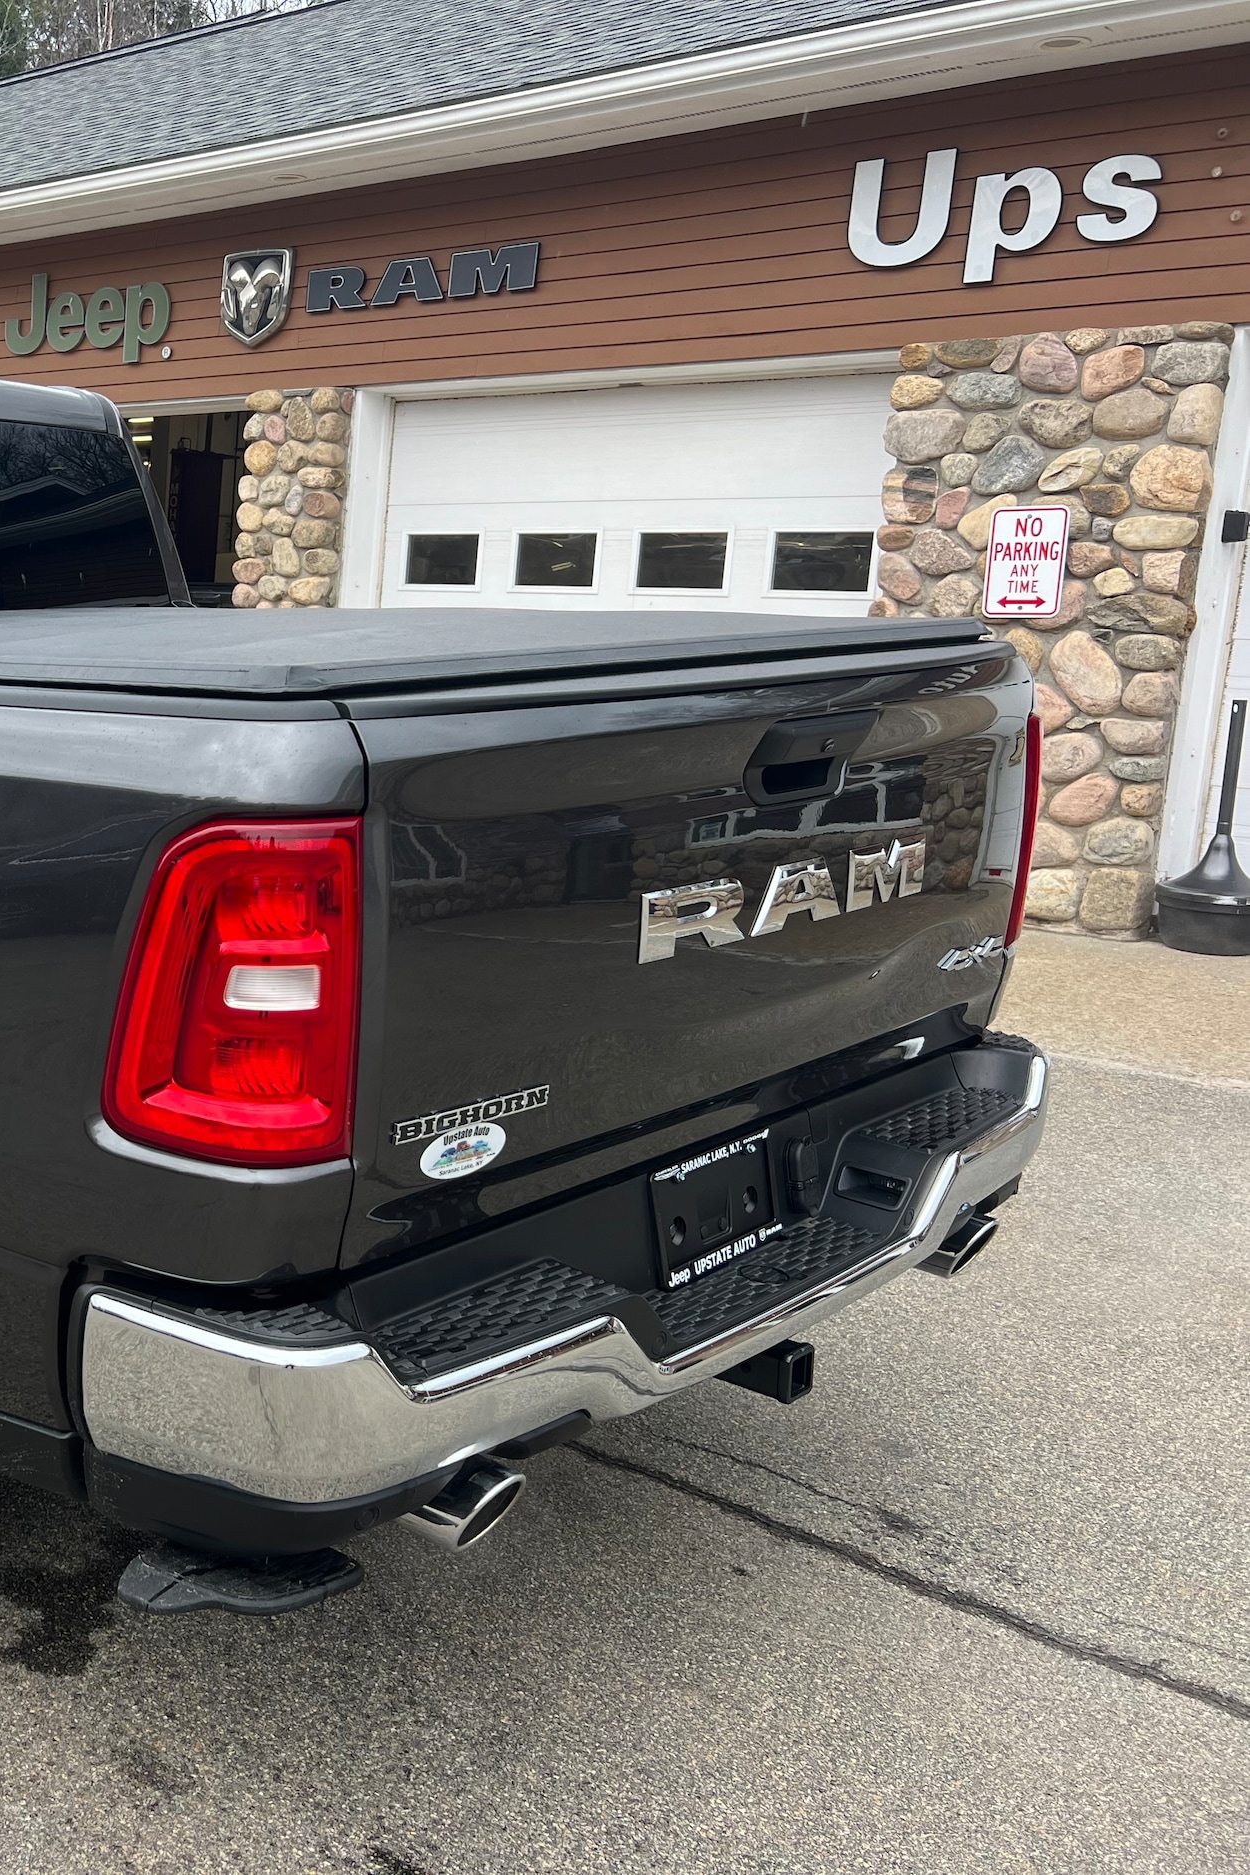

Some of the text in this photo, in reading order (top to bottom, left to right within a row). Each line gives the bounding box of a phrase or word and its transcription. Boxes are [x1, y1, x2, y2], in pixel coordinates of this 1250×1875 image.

[847, 147, 1163, 284] Ups
[305, 241, 540, 313] RAM
[5, 273, 171, 363] Jeep
[1015, 517, 1043, 537] NO
[994, 541, 1059, 561] PARKING
[1010, 564, 1039, 577] ANY
[1007, 580, 1039, 593] TIME
[639, 833, 926, 964] RAM
[391, 1085, 549, 1145] BIGHORN
[443, 1126, 490, 1146] Upstate Auto
[681, 1153, 710, 1174] SARANAC
[711, 1146, 729, 1159] LAKE,
[669, 1268, 690, 1287] Jeep
[694, 1245, 732, 1275] UPSTATE
[733, 1234, 756, 1256] AUTO
